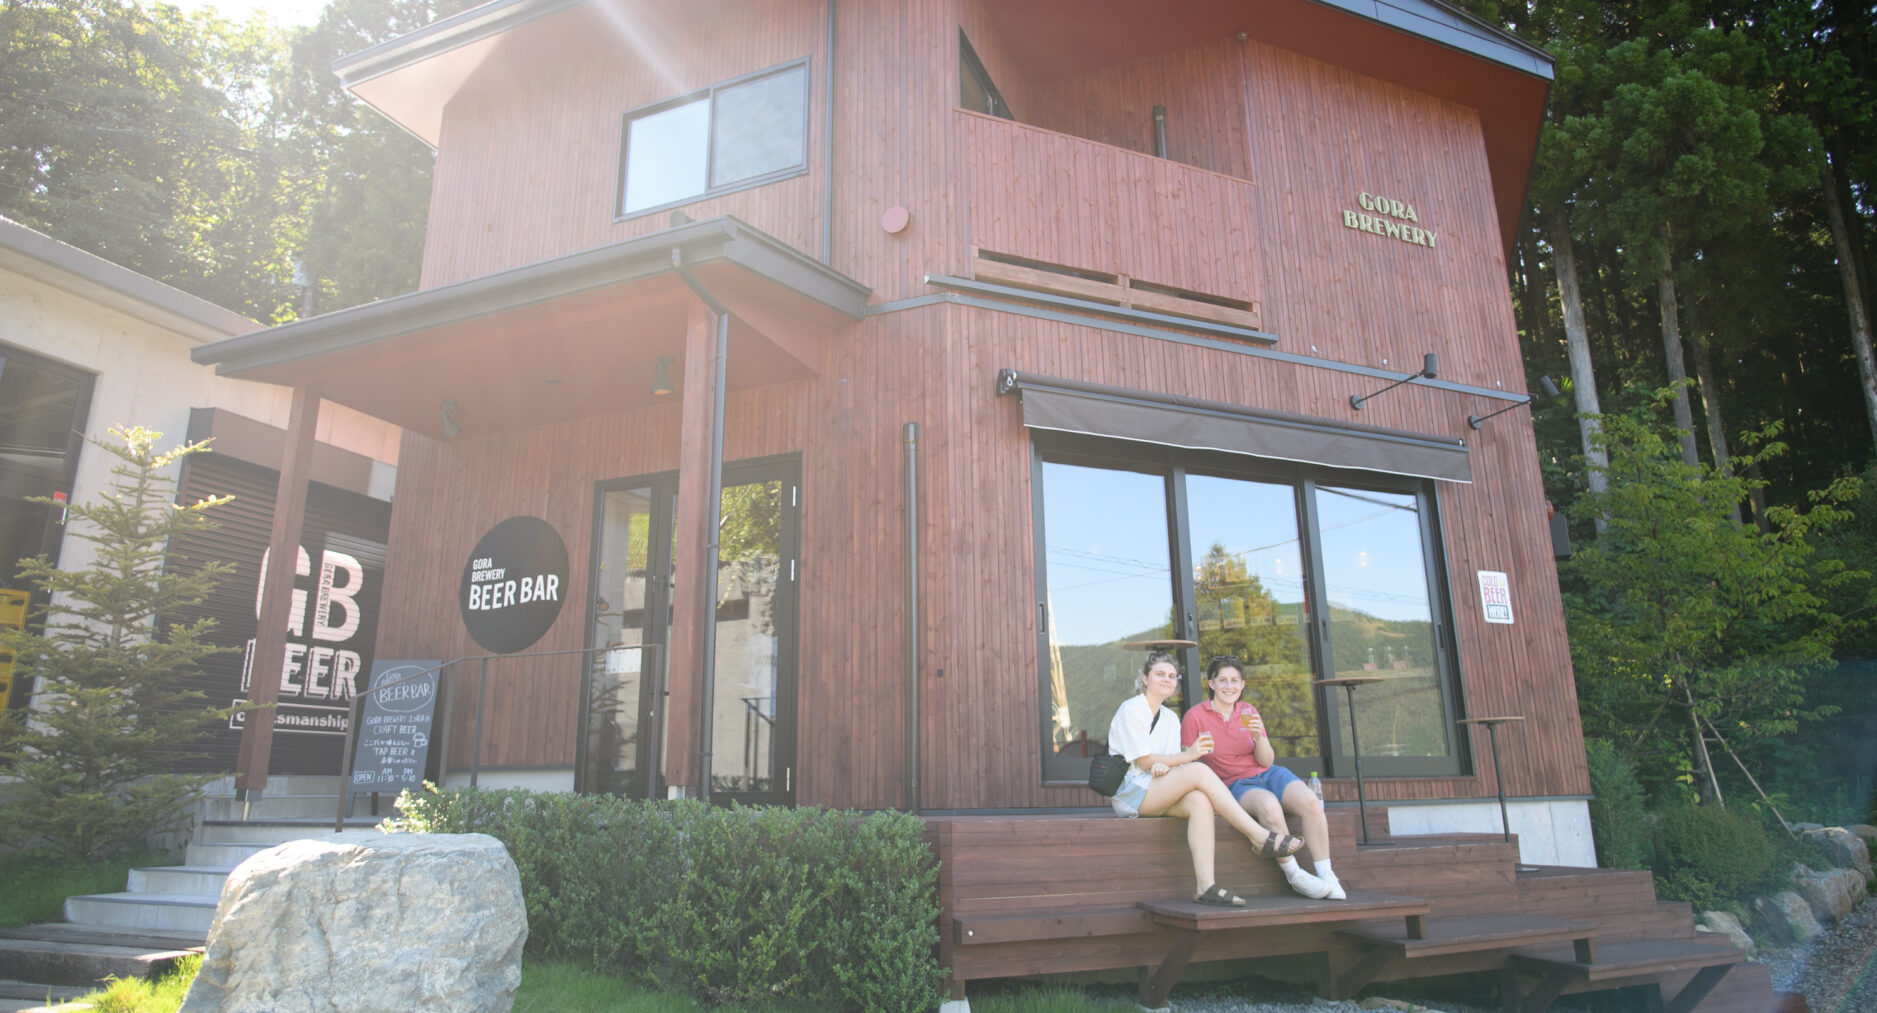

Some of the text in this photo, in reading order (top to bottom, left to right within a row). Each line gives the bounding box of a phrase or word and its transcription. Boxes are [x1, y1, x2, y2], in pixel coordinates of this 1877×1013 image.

[1358, 192, 1418, 222] GORA
[1343, 209, 1437, 248] BREWERY
[473, 557, 493, 570] GORA
[471, 568, 505, 582] BREWERY
[1481, 575, 1499, 587] COLD
[468, 574, 559, 611] BEER BAR
[1483, 587, 1508, 604] BEER
[241, 637, 361, 700] EER
[379, 685, 410, 704] BEER
[411, 682, 431, 699] BAR
[236, 711, 350, 731] csmanship
[399, 724, 417, 734] BEER
[389, 747, 408, 756] BEER
